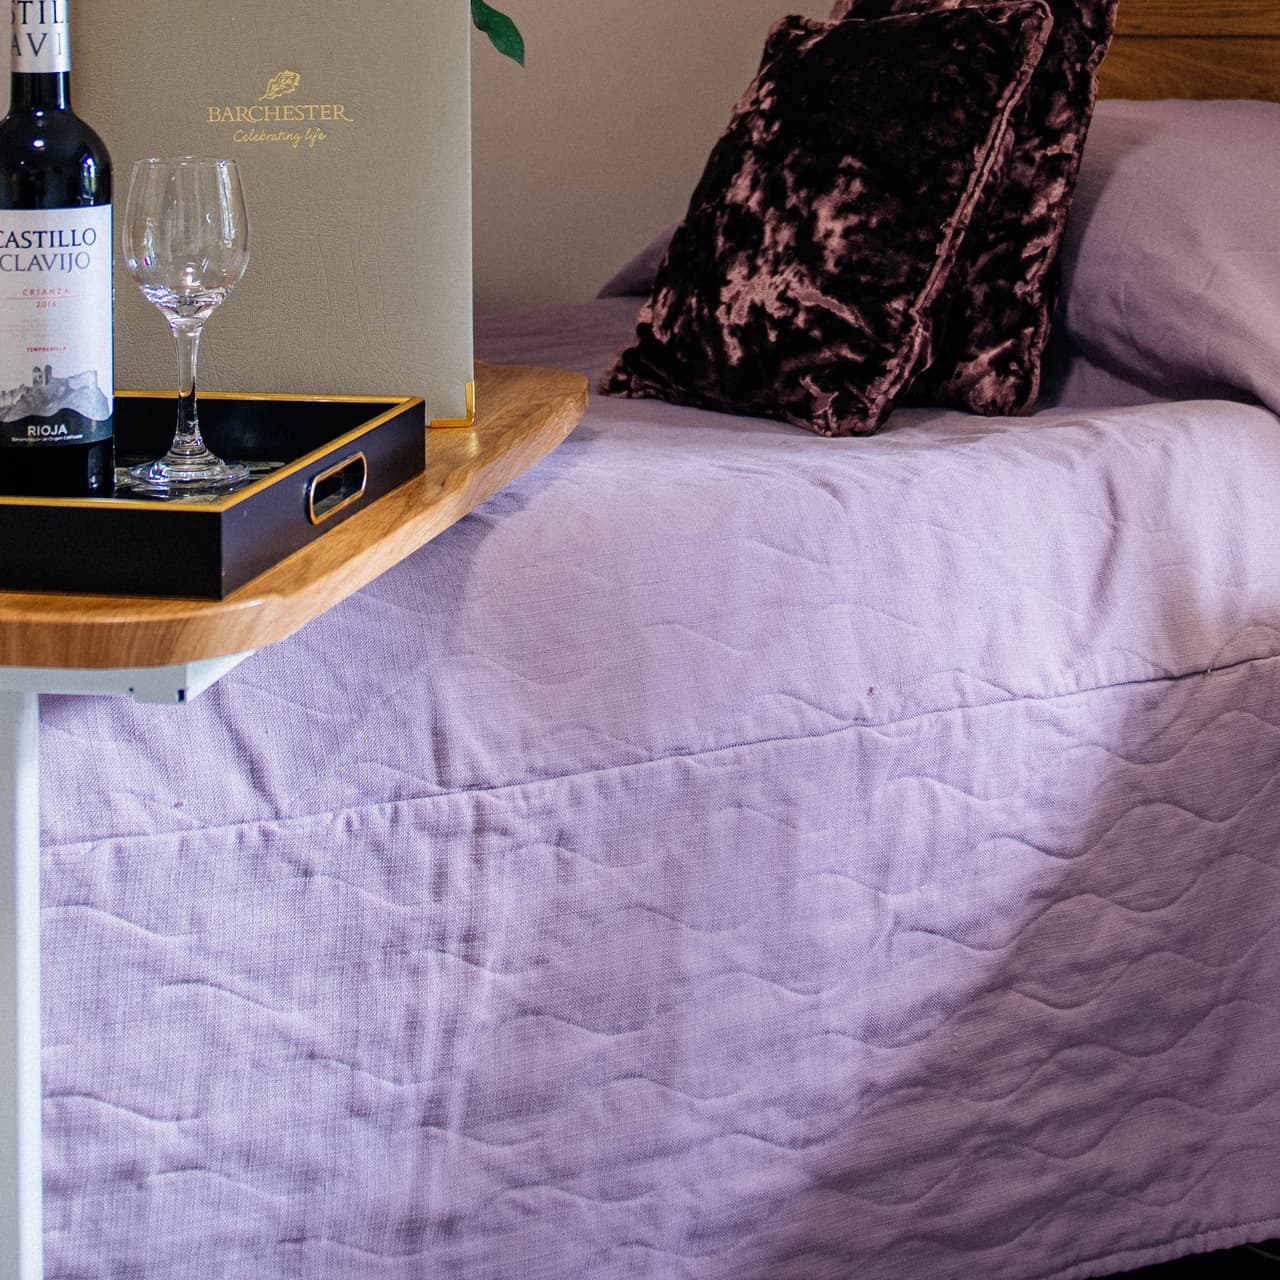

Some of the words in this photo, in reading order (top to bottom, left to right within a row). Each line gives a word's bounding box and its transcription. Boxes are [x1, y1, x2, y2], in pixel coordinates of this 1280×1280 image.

[207, 104, 354, 124] BARCHESTER
[232, 128, 302, 148] Celebrating
[305, 127, 327, 148] life
[0, 252, 91, 273] CLAVIJO
[22, 288, 70, 296] CRIANZA
[27, 424, 68, 436] RIOJA
